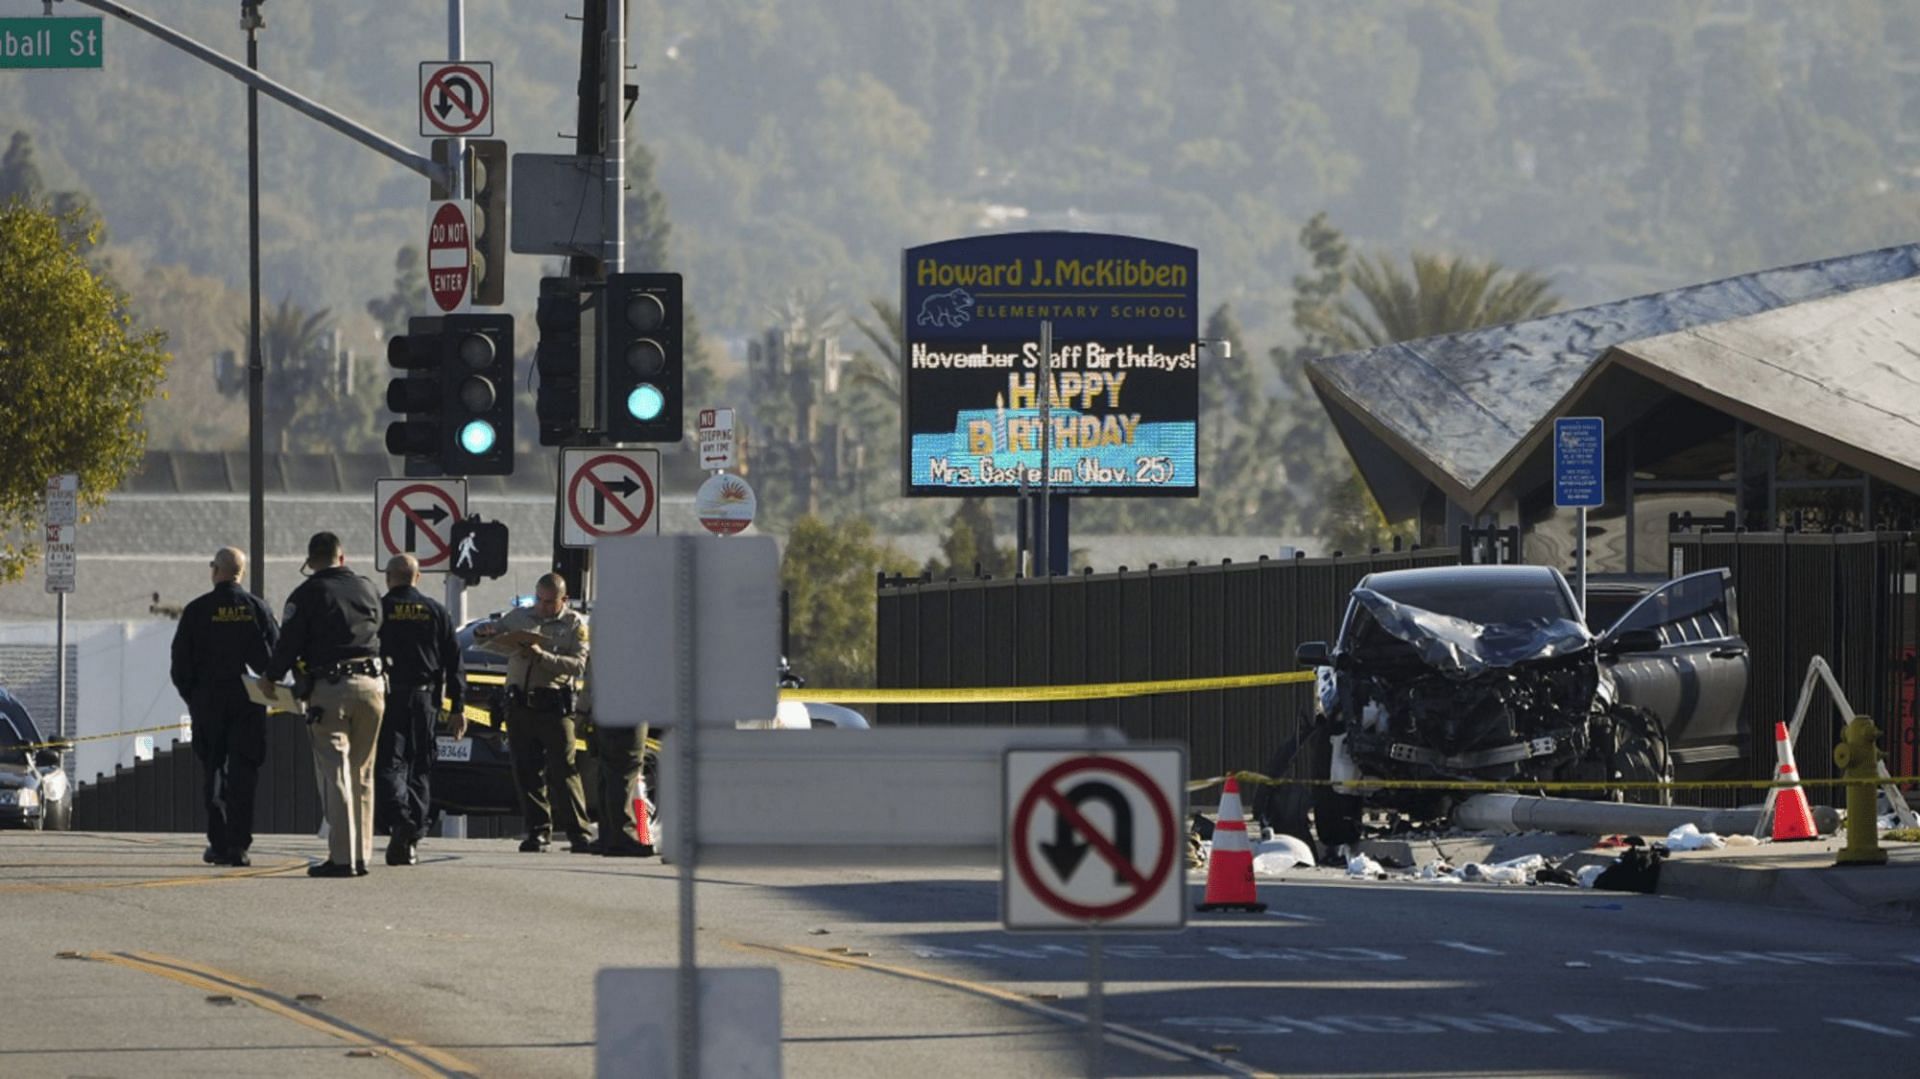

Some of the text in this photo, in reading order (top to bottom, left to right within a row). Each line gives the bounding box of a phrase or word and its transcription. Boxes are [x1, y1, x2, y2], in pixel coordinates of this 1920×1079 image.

[0, 29, 97, 56] ball St
[432, 223, 465, 243] DO NOT
[434, 274, 463, 292] ENTER
[917, 258, 1188, 287] Howard J. McKibben
[976, 304, 1187, 318] ELEMENTARY SCHOOL
[911, 341, 1196, 372] November Saff Birthdays!
[1008, 371, 1127, 410] HAPPY
[701, 412, 714, 427] NO
[929, 457, 977, 483] Mrs.
[1078, 456, 1131, 483] (Nov.
[1135, 455, 1174, 483] 25)
[1162, 1012, 1780, 1035] SIGNAL
